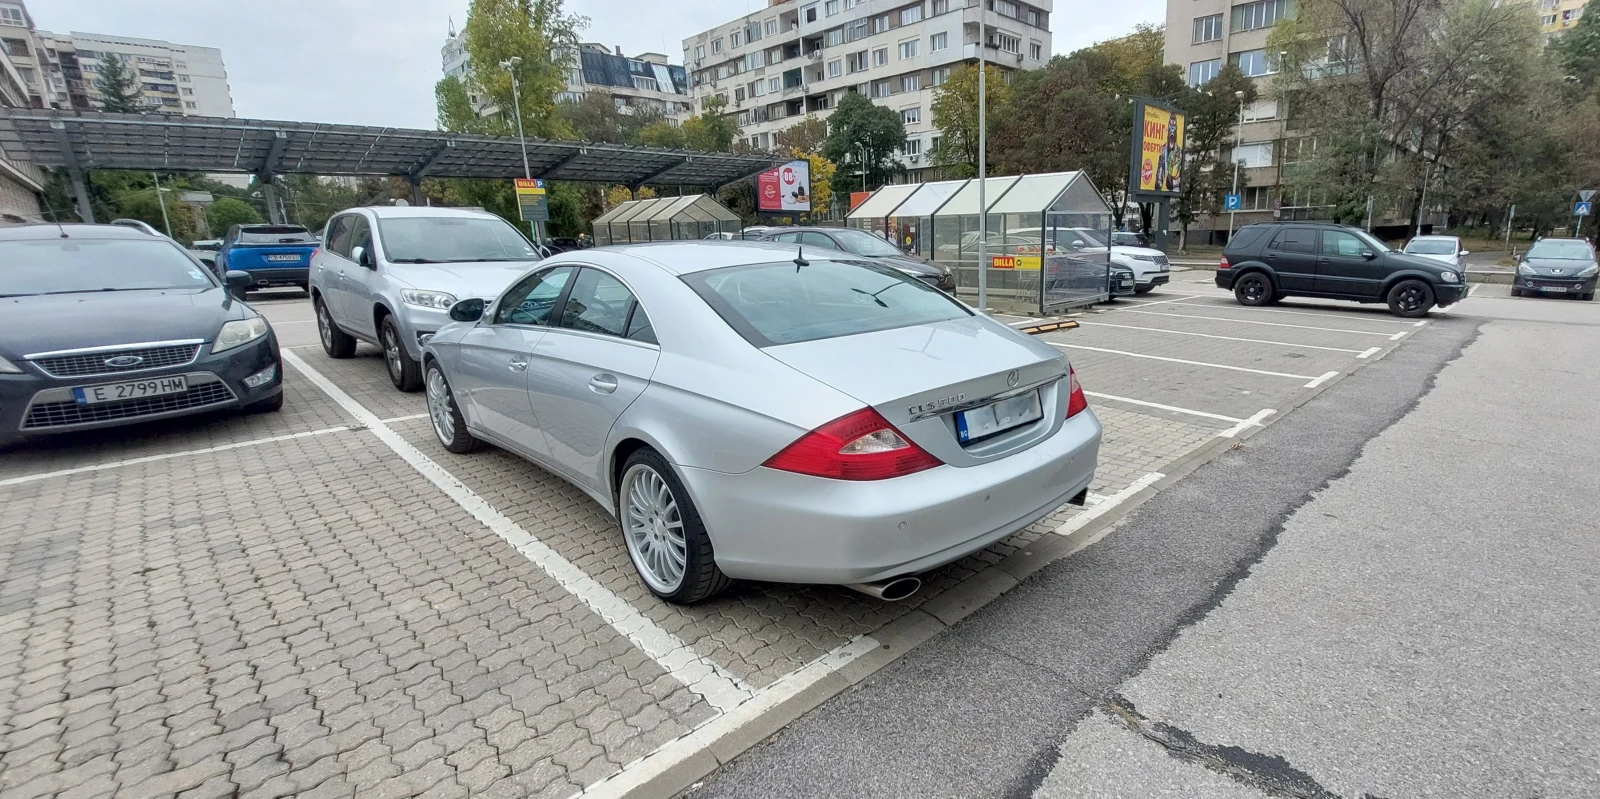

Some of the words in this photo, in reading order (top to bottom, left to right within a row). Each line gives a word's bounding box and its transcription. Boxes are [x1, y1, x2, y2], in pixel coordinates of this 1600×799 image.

[1143, 120, 1166, 141] КИНГ
[1229, 197, 1237, 208] P
[993, 258, 1014, 267] BILLA
[94, 387, 107, 400] E
[115, 382, 158, 398] 2799
[161, 378, 184, 392] HM
